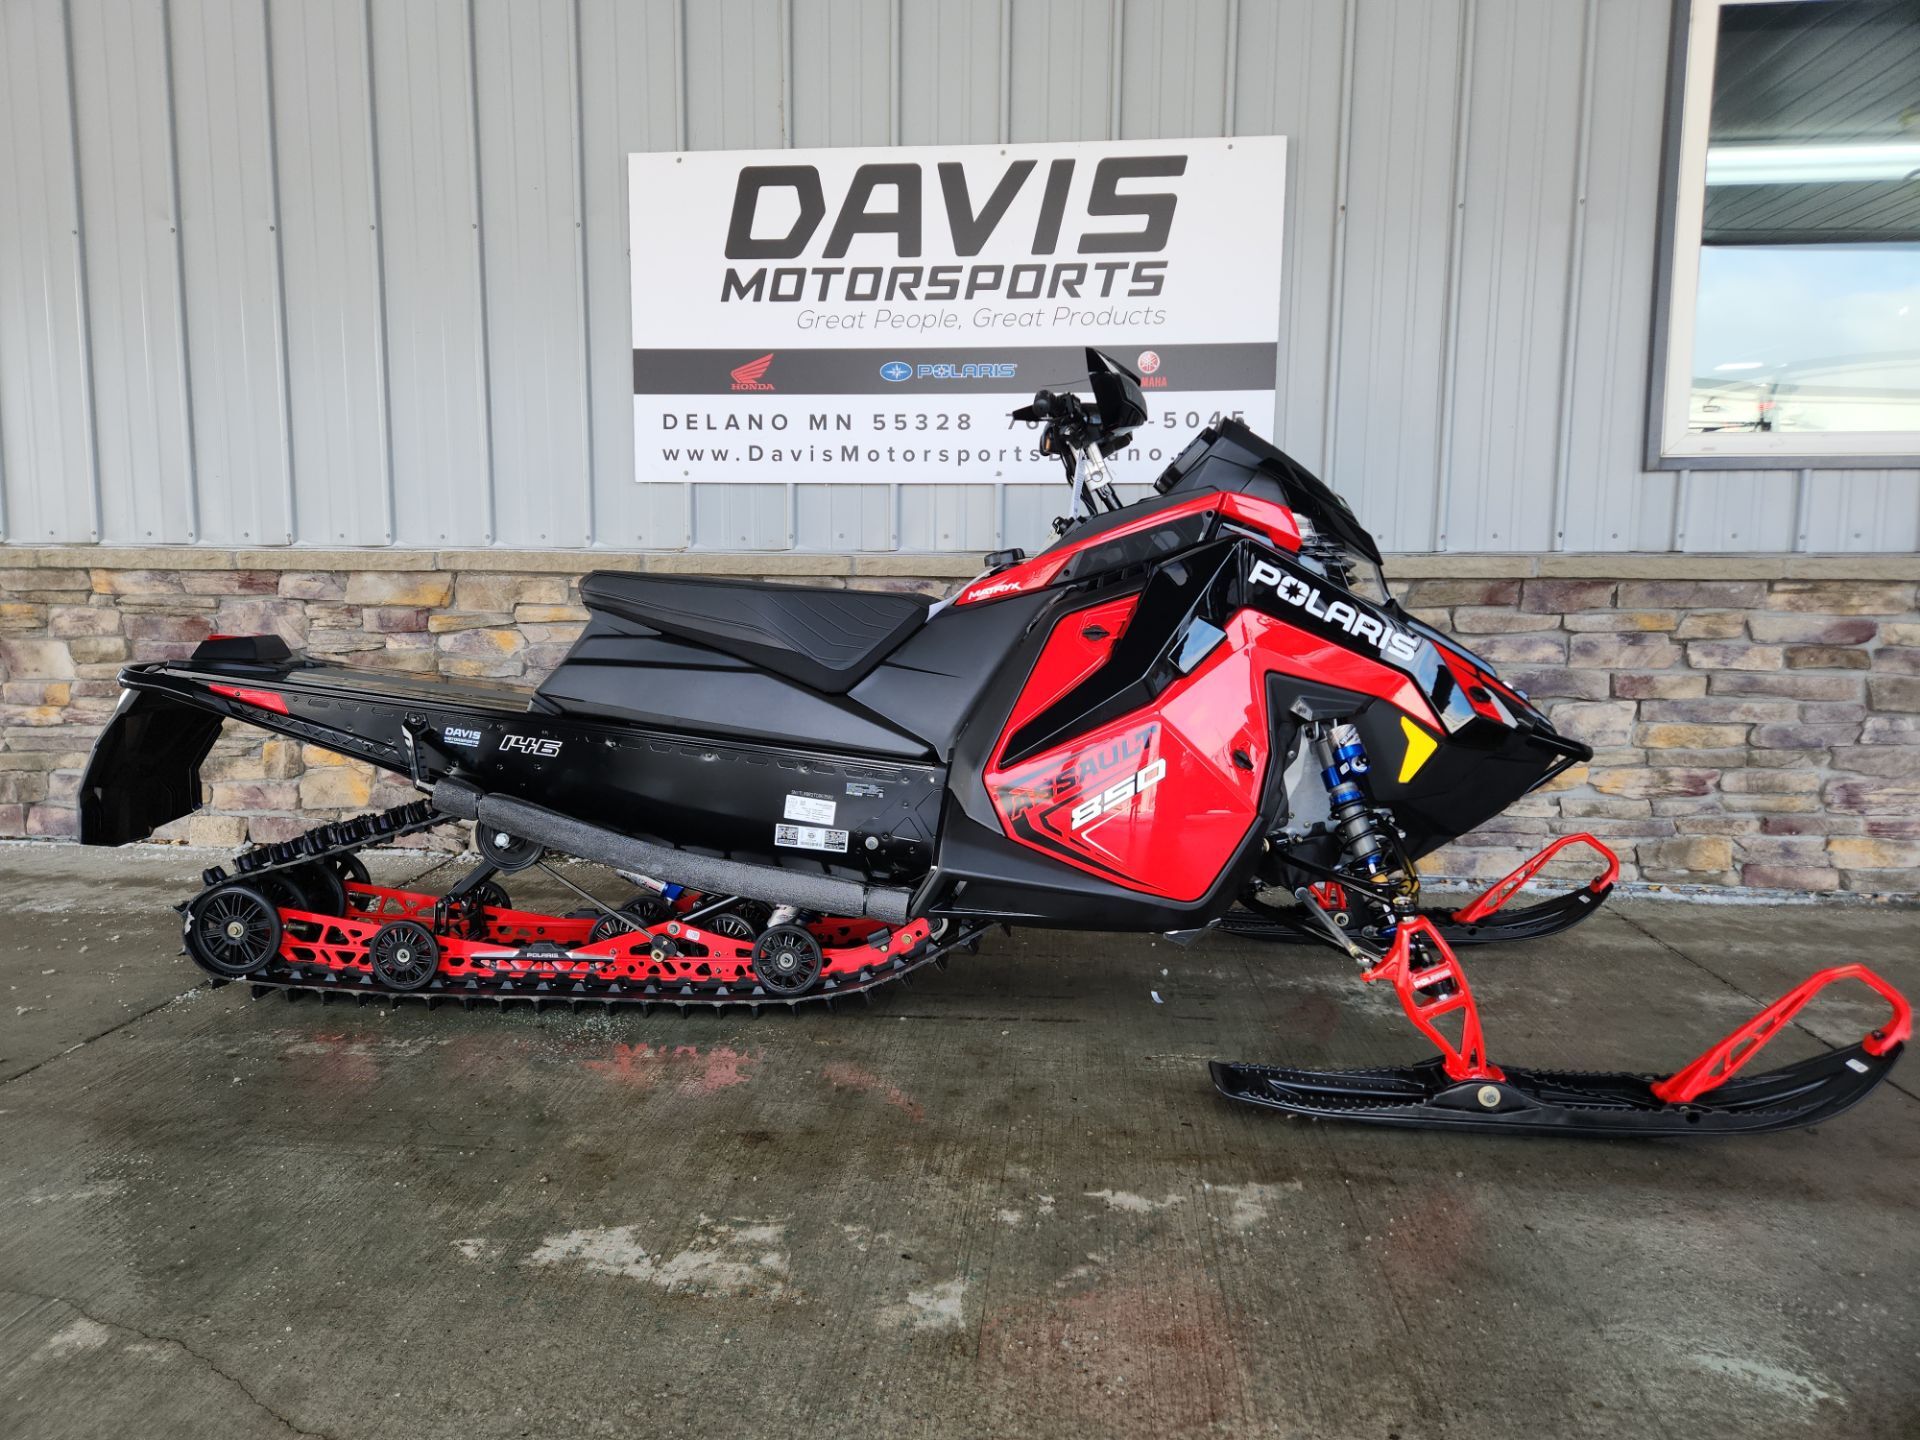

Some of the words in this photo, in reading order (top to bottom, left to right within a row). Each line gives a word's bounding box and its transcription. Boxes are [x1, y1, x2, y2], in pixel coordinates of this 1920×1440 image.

[724, 154, 1188, 259] DAVIS
[721, 260, 1169, 302] MOTORSPORTS
[796, 309, 866, 330] Great
[873, 308, 962, 334] People,
[972, 307, 1046, 329] Great
[1052, 305, 1167, 327] Products
[917, 363, 1016, 379] POLARIS
[1140, 375, 1169, 388] MAHA
[731, 383, 776, 391] HONDA
[662, 413, 789, 431] DELANO
[809, 413, 852, 431] MN
[872, 413, 972, 431] 55328
[1248, 559, 1418, 662] POLARIS
[444, 726, 482, 741] DAVIS
[499, 734, 563, 757] 146
[1010, 724, 1158, 821] ASSAULT
[1071, 758, 1167, 831] 850
